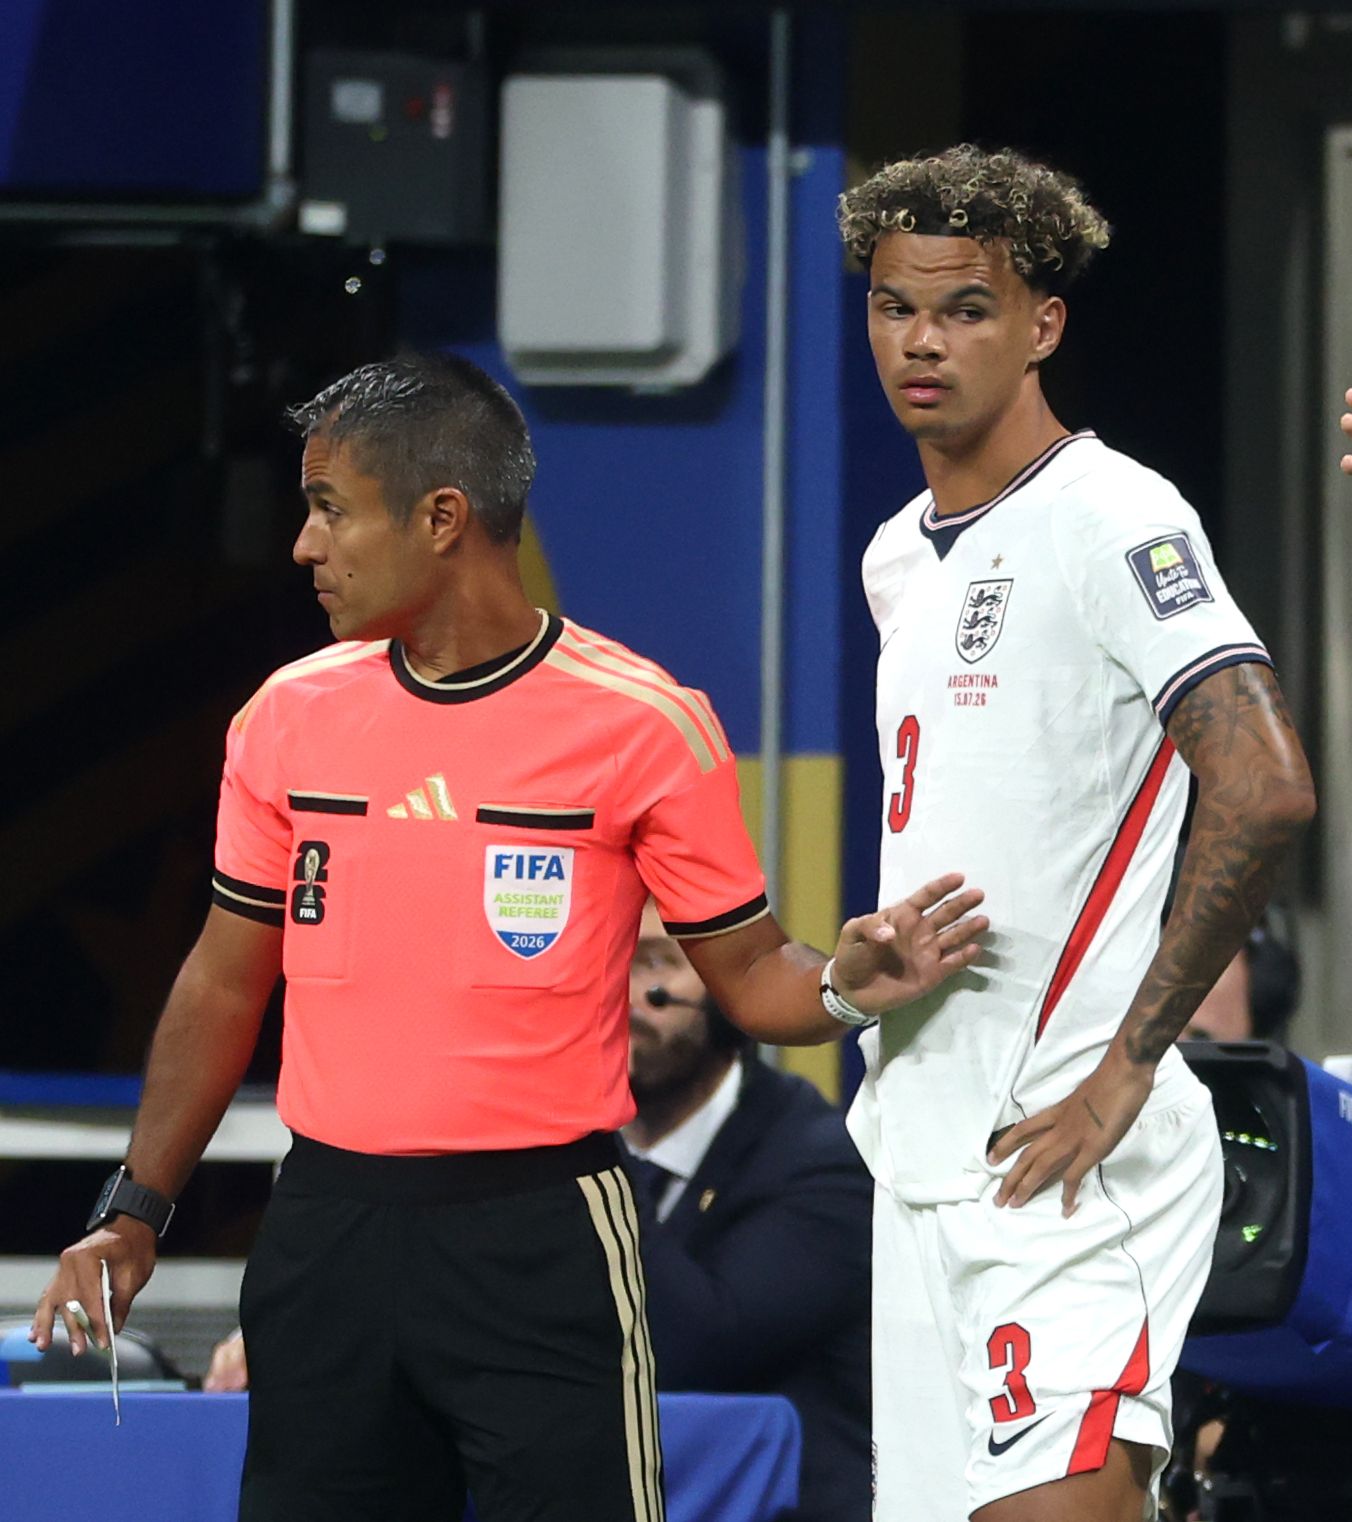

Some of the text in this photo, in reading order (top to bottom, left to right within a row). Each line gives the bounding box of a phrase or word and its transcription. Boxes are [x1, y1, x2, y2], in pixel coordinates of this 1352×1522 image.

[947, 674, 998, 688] ARGENTINA
[888, 715, 920, 833] 3
[494, 854, 565, 880] FIFA
[493, 893, 564, 905] ASSISTANT
[299, 907, 317, 919] FIFA
[498, 905, 559, 919] REFEREE
[511, 935, 545, 948] 2026
[987, 1322, 1037, 1423] 3
